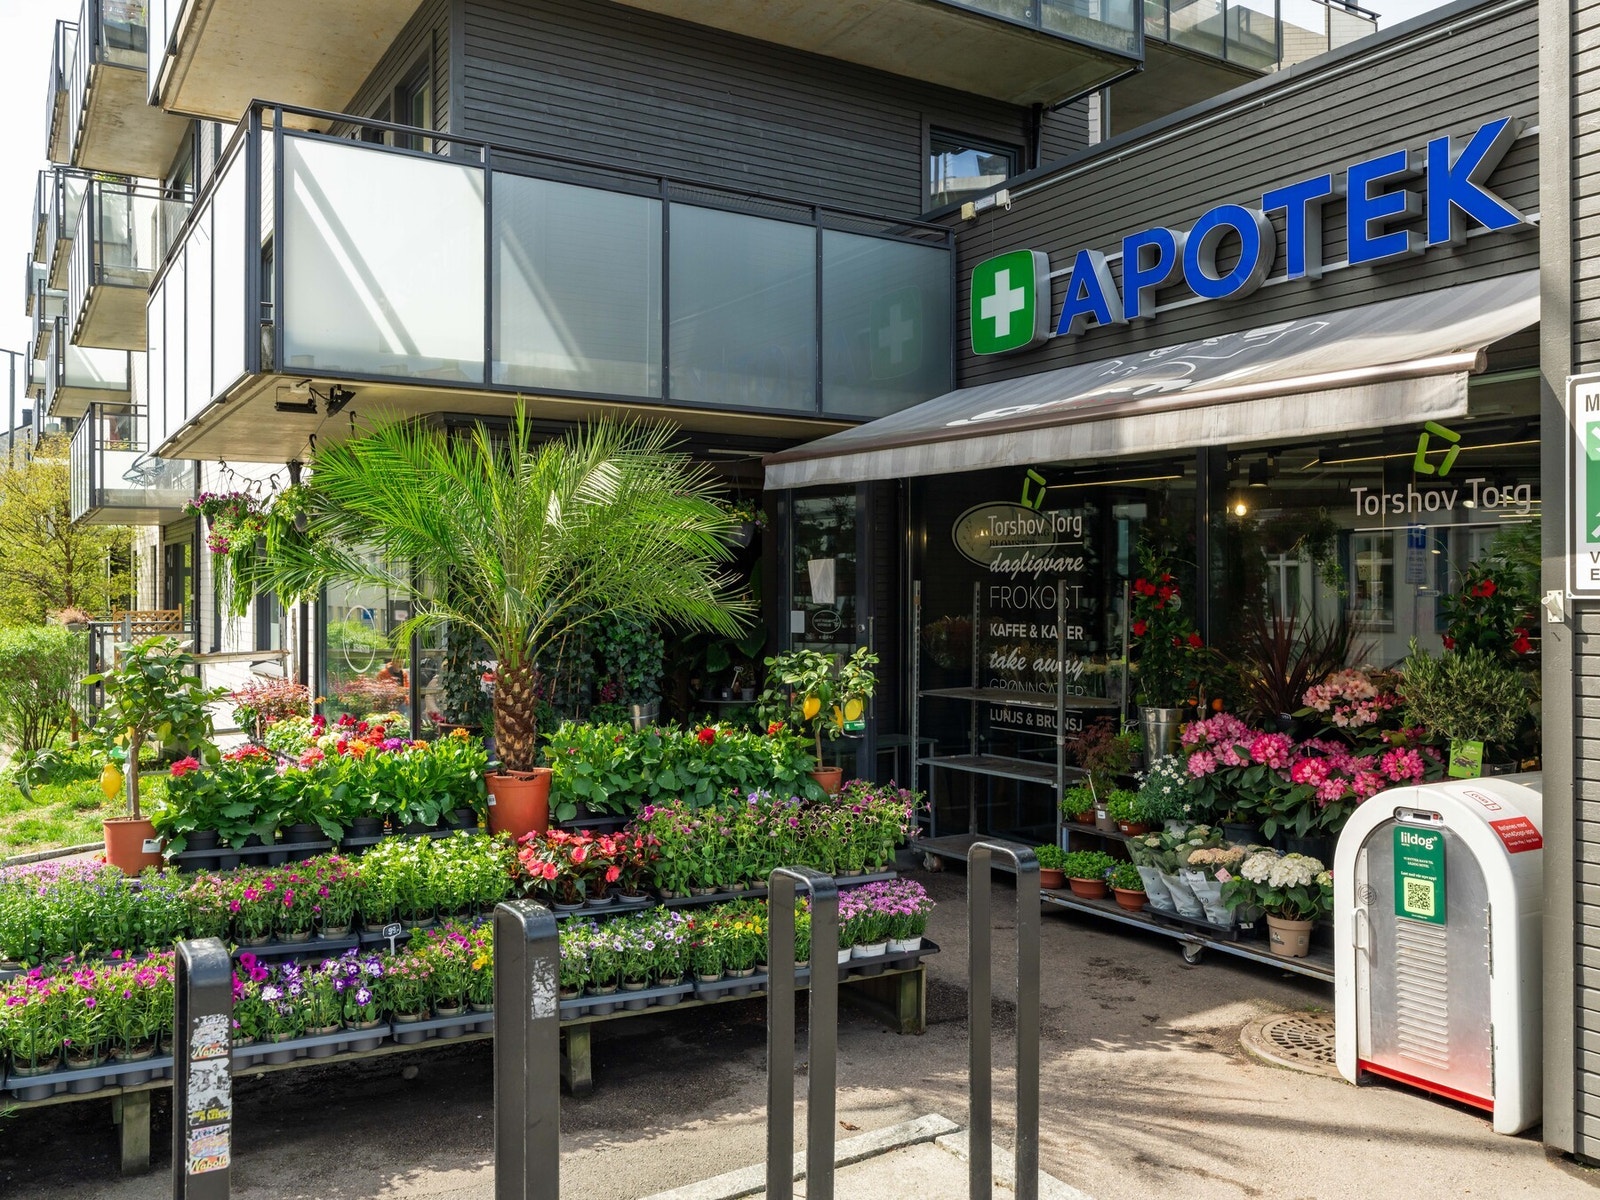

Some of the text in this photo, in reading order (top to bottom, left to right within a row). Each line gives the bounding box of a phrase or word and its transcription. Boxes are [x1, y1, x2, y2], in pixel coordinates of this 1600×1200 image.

[1055, 116, 1522, 336] APOTEK
[1350, 477, 1531, 516] Torshov Torg
[987, 510, 1083, 538] Torshov Torg
[989, 550, 1084, 580] dagligvare
[989, 623, 1084, 640] KAFFE & KAER
[989, 647, 1028, 671] take
[989, 708, 1024, 724] LUNJS
[1025, 713, 1034, 726] &
